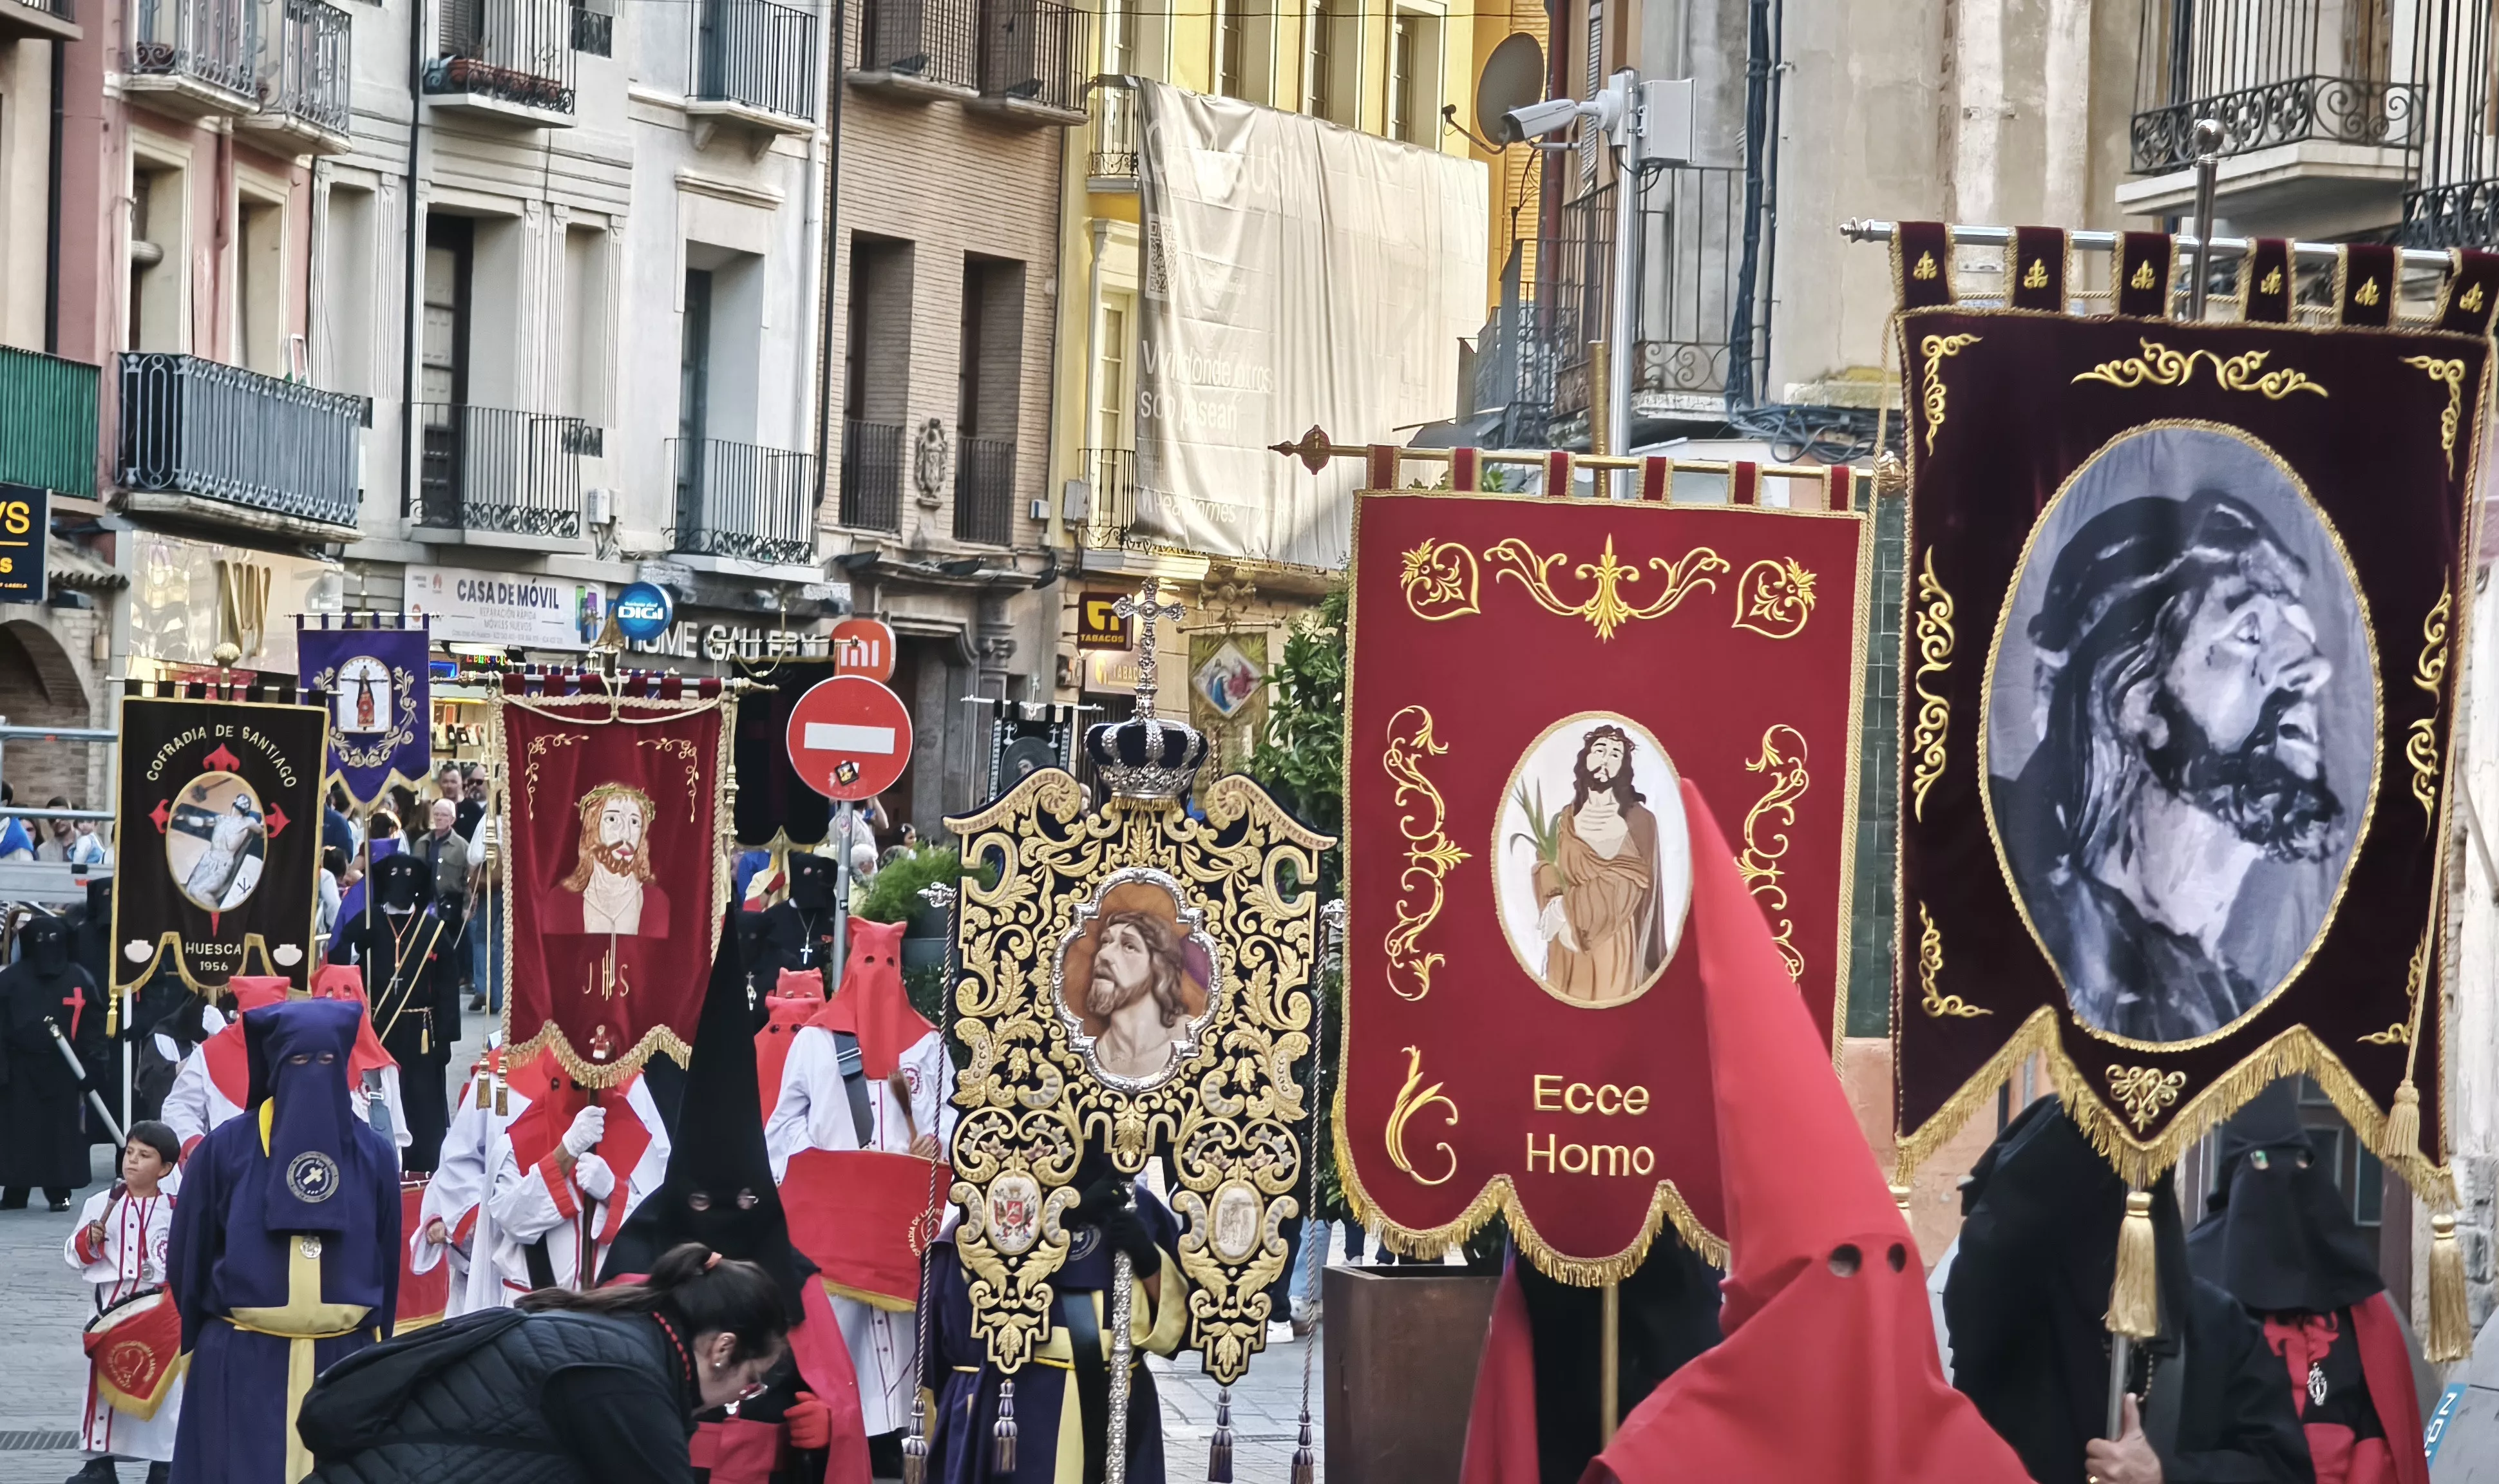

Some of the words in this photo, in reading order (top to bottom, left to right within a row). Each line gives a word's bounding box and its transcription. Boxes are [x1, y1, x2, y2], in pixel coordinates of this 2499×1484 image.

[1183, 347, 1231, 386] donde
[457, 579, 495, 604] CASA
[498, 582, 515, 606] DE
[517, 577, 560, 609] MÓVIL
[618, 605, 663, 620] DIGI
[1080, 634, 1125, 643] TABACOS
[147, 727, 206, 781] COFRADIA
[216, 724, 234, 737] DE
[242, 726, 297, 787] SANTIAGO
[185, 942, 242, 955] HUESCA
[200, 960, 229, 971] 1956
[1534, 1074, 1650, 1116] Ecce
[1526, 1132, 1655, 1177] Homo
